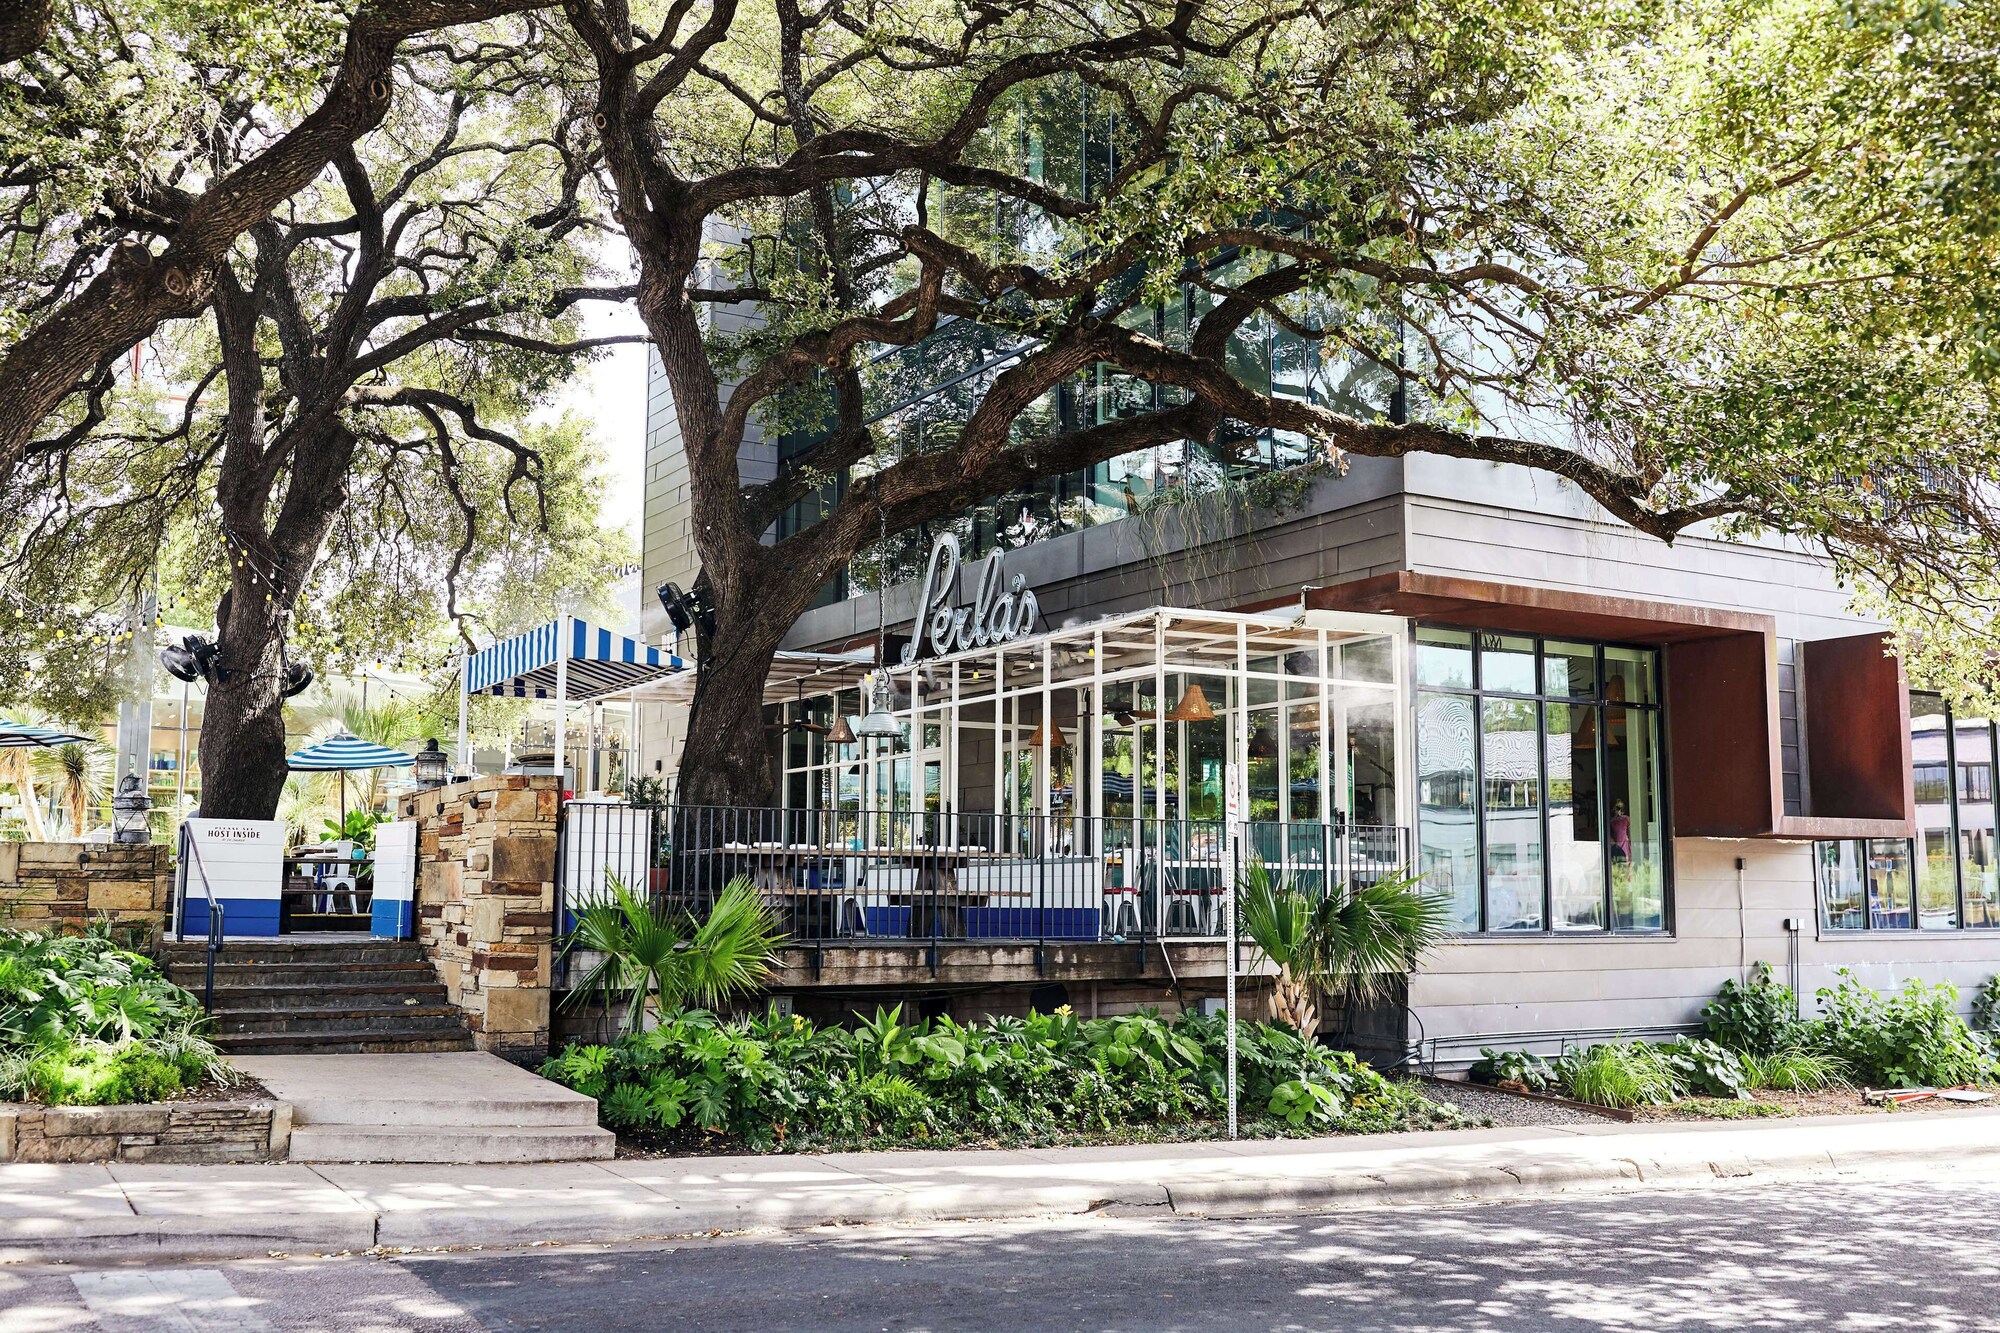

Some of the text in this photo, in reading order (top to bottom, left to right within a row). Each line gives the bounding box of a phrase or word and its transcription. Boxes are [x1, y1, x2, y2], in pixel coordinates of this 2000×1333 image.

[901, 532, 1038, 664] Perla's
[208, 830, 260, 839] HOST INSIDE
